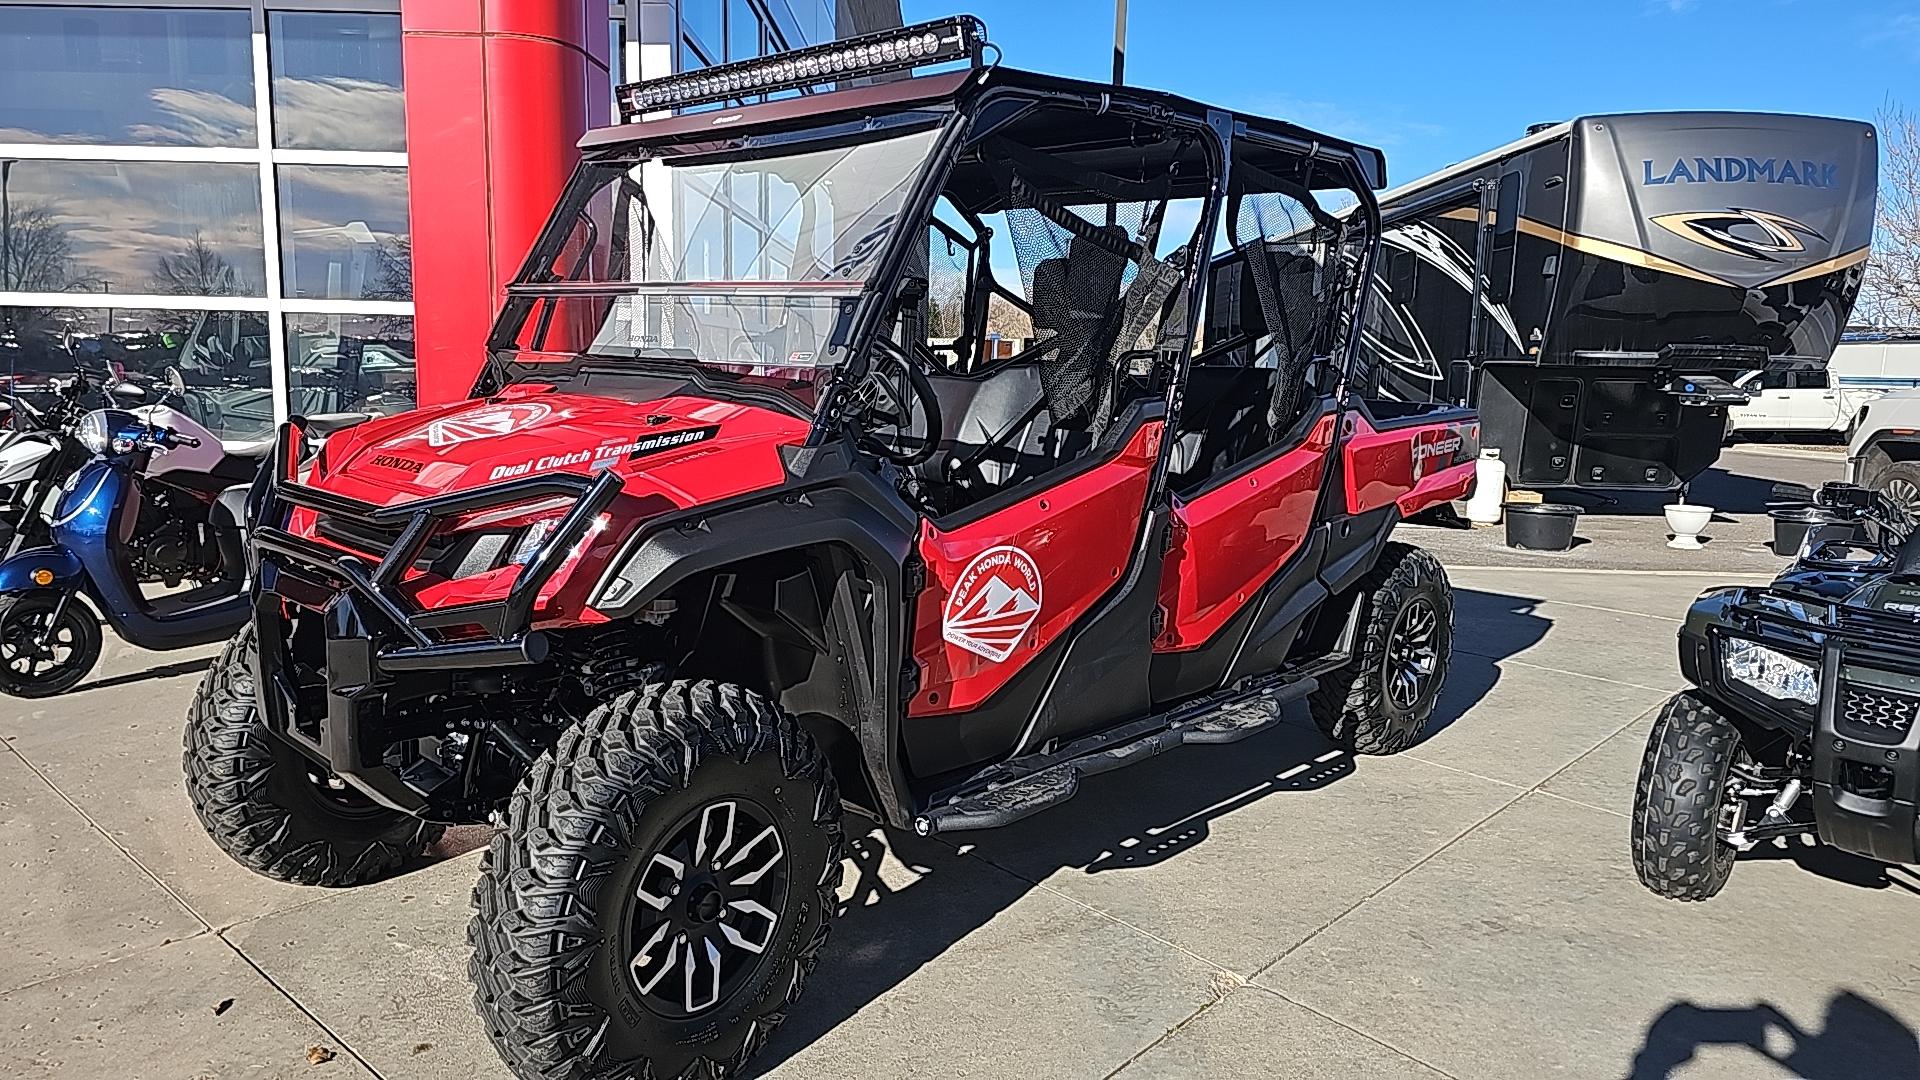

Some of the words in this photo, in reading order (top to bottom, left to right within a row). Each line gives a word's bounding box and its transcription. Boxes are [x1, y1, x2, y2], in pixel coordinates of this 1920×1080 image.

[1642, 157, 1839, 189] LANDMARK
[370, 454, 425, 474] HONDA
[489, 459, 532, 481] Dual
[535, 450, 591, 471] Clutch
[594, 430, 705, 460] Transmission
[954, 571, 978, 607] PEAK
[976, 552, 1012, 575] HONDA
[1013, 556, 1037, 592] WORLD
